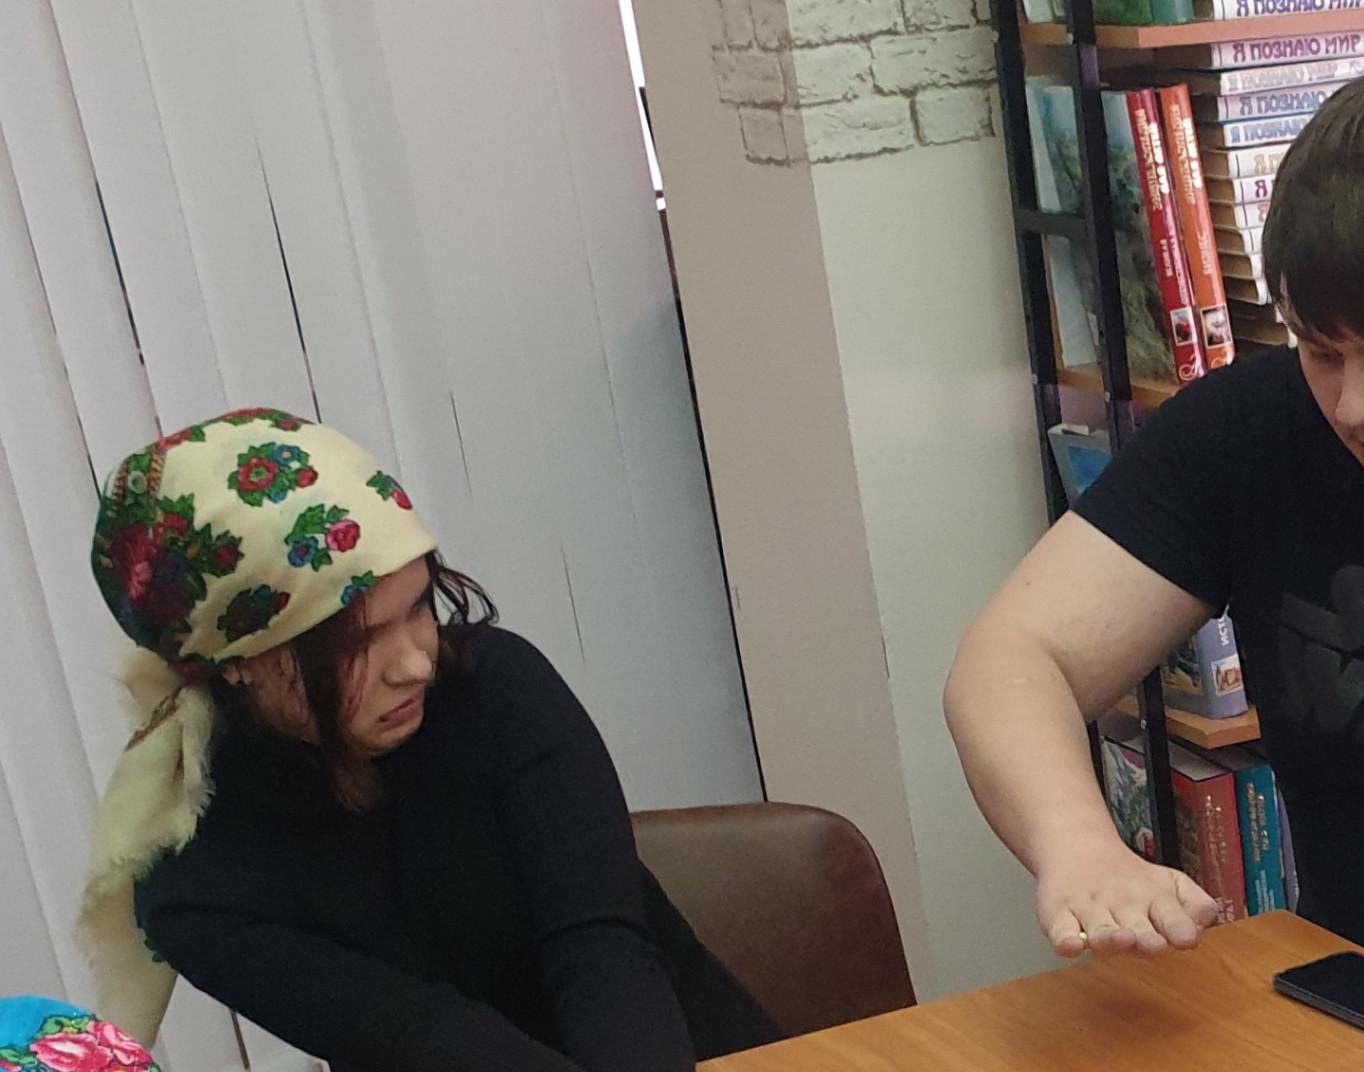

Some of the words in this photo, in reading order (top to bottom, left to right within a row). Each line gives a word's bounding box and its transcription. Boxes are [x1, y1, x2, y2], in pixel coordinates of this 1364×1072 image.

[1237, 0, 1249, 16] Я
[1233, 43, 1246, 63] Я
[1250, 38, 1321, 60] ПОЗНАЮ
[1325, 34, 1361, 53] МИР
[1240, 96, 1253, 116] Я
[1254, 179, 1268, 198] Я
